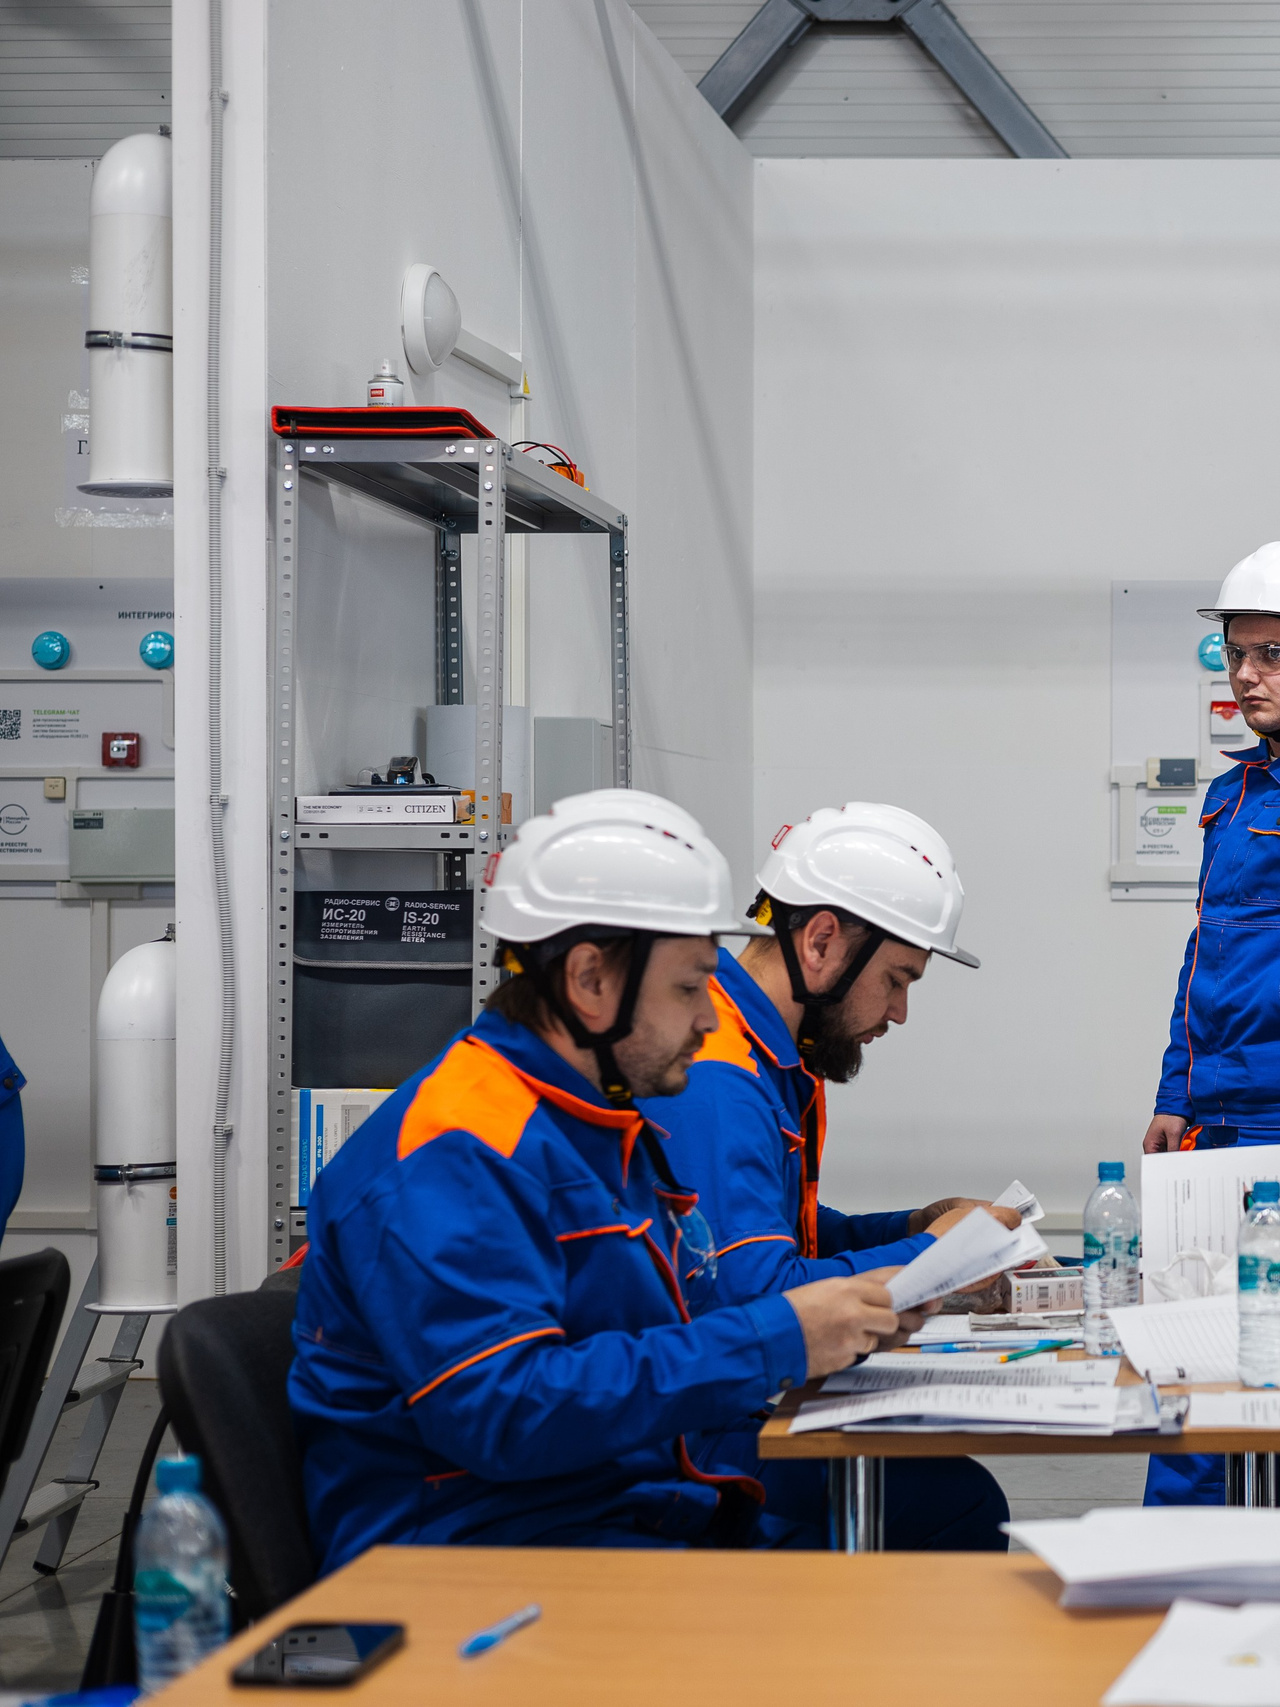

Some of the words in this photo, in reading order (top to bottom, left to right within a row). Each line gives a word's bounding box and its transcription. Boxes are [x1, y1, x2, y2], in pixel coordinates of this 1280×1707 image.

[404, 804, 447, 814] CITIZEN
[324, 897, 381, 907] РАДИО-СЕРВИС
[404, 901, 460, 911] RADIO-SERVICE
[322, 908, 366, 922] ИС-20
[403, 911, 440, 925] IS-20
[320, 928, 378, 936] СОПРОТИВЛЕНИЯ
[401, 931, 446, 939] RESISTANCE
[400, 936, 426, 944] METER
